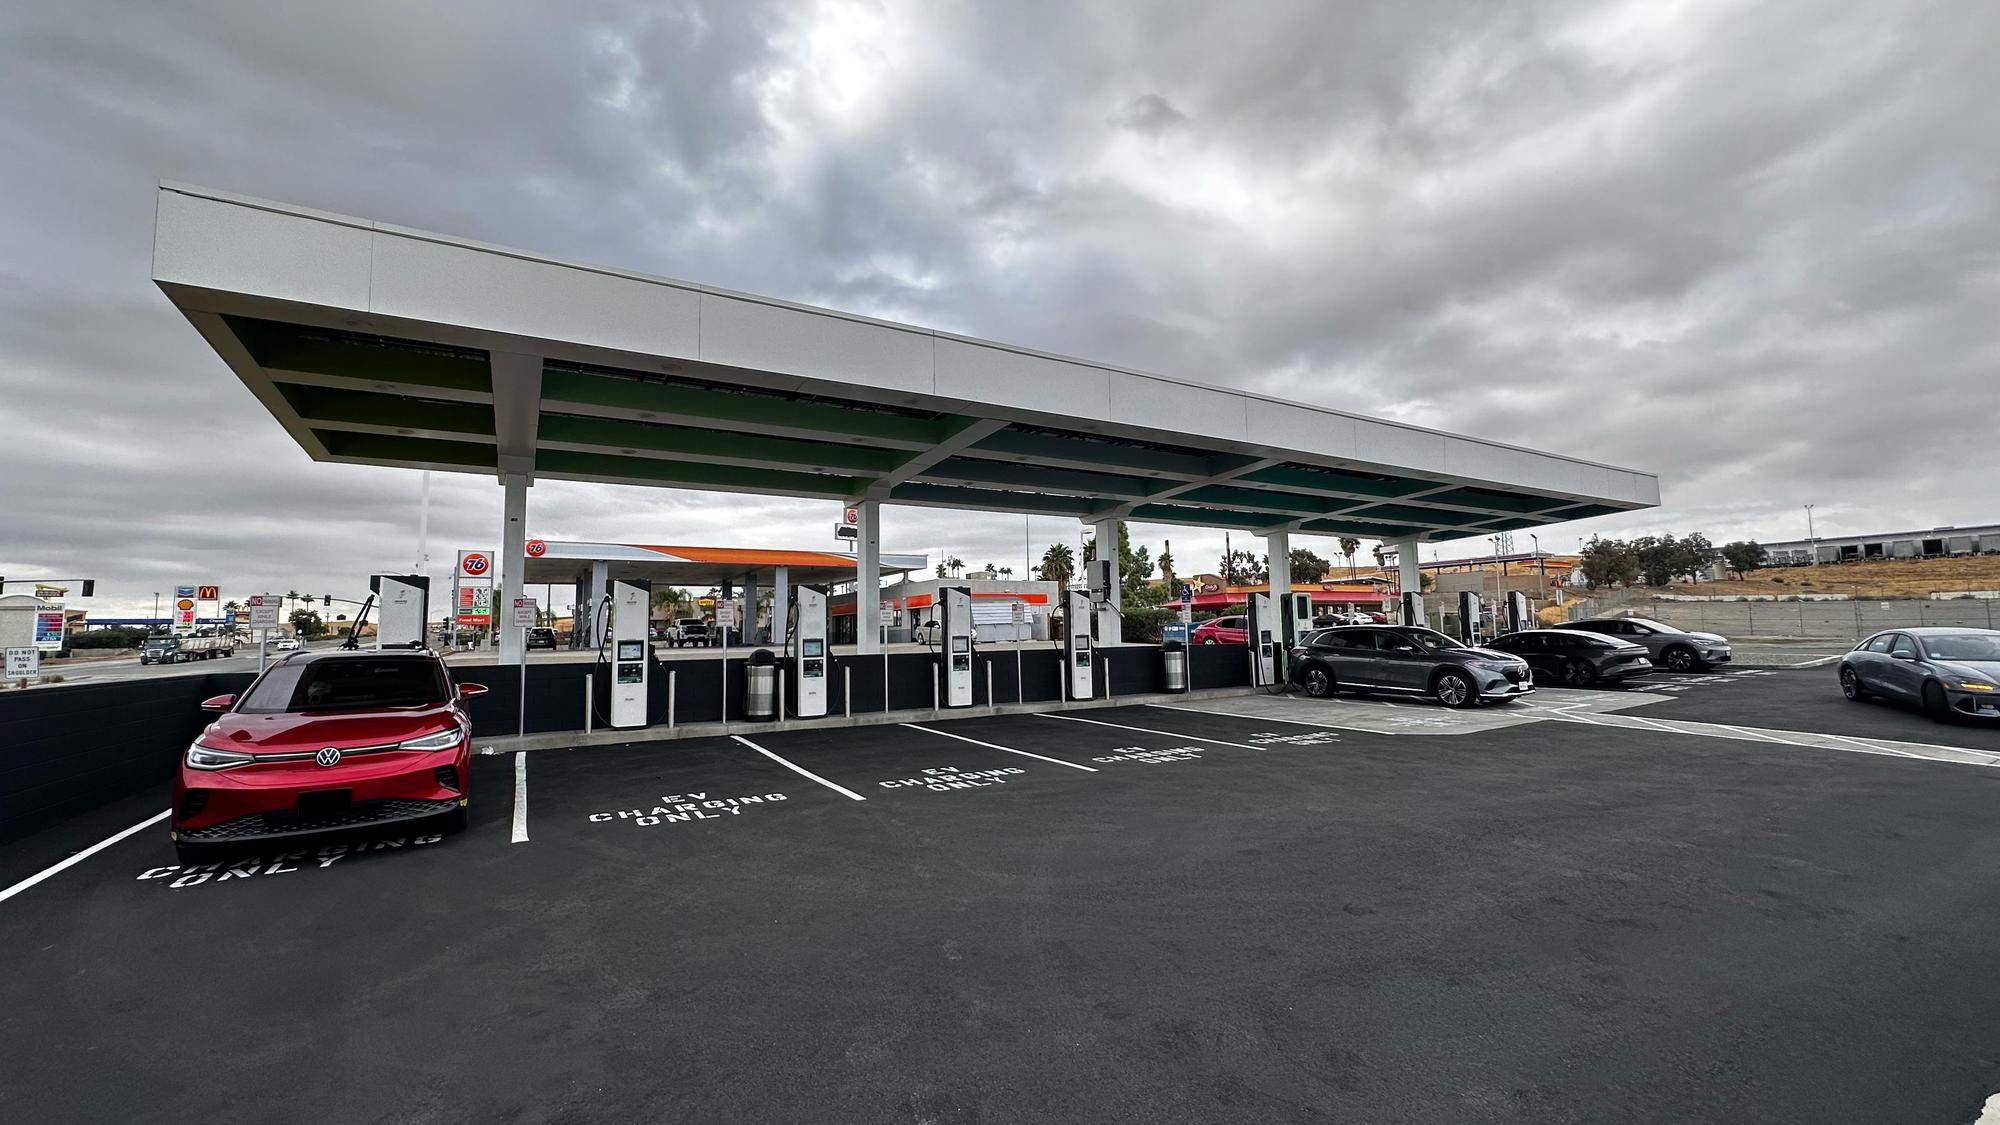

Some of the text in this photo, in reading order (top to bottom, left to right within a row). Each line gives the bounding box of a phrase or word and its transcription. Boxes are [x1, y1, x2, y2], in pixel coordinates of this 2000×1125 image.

[529, 543, 543, 553] 76
[466, 558, 485, 571] 76
[251, 597, 262, 605] NO
[879, 767, 1026, 788] CHARGING
[921, 766, 960, 775] EV
[926, 776, 1007, 791] ONLY
[661, 792, 706, 804] EV
[588, 793, 788, 822] CHARGING
[635, 805, 741, 827] ONLY
[168, 854, 347, 889] ONLY
